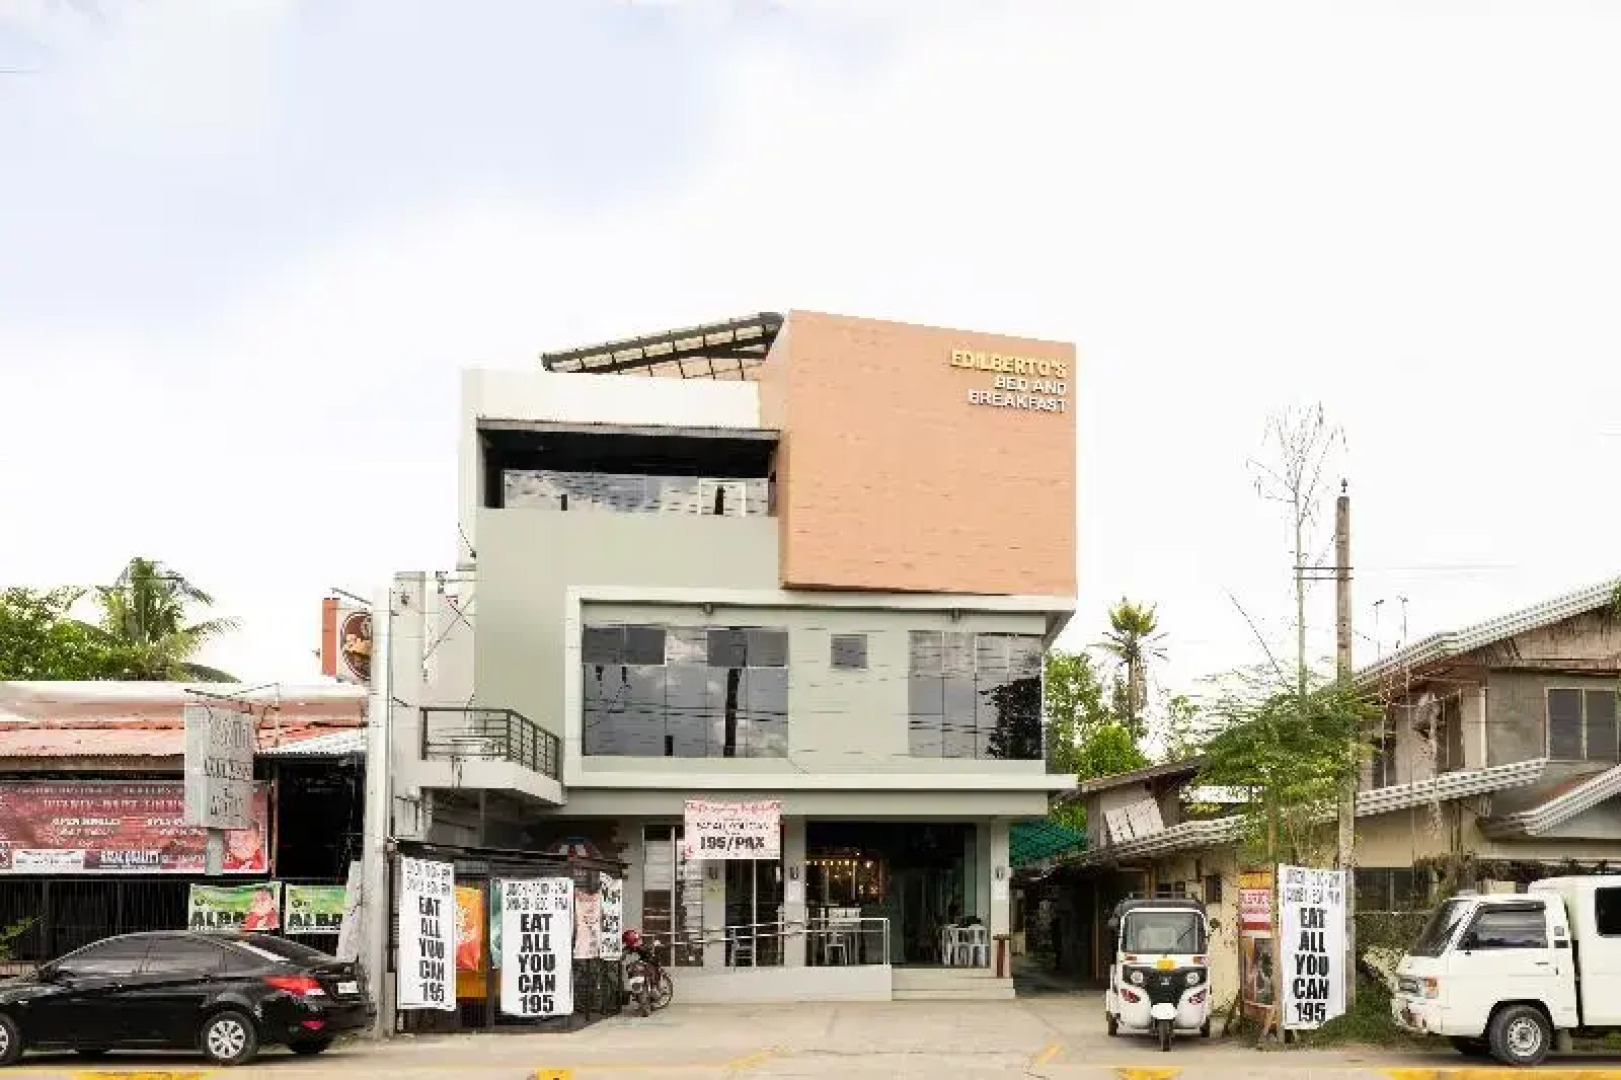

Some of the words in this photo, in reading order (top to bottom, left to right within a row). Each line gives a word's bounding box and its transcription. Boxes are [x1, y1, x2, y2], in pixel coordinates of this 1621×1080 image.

[951, 350, 1067, 379] EDILBERTO'S
[995, 375, 1027, 393] BED
[1031, 379, 1066, 396] AND
[968, 389, 1066, 413] BREAKFAST
[700, 836, 765, 851] 195/PAX
[419, 896, 441, 916] EAT
[520, 914, 553, 932] EAT
[1300, 907, 1327, 928] EAT
[421, 918, 441, 938] ALL
[419, 938, 445, 960] YOU
[521, 934, 551, 952] ALL
[1298, 931, 1326, 953] ALL
[419, 960, 445, 981] CAN
[518, 954, 555, 973] YOU
[1295, 954, 1330, 977] YOU
[419, 982, 445, 1002] 195
[518, 974, 555, 993] CAN
[1293, 978, 1330, 1000] CAN
[519, 994, 554, 1013] 195
[1295, 1002, 1326, 1022] 195
